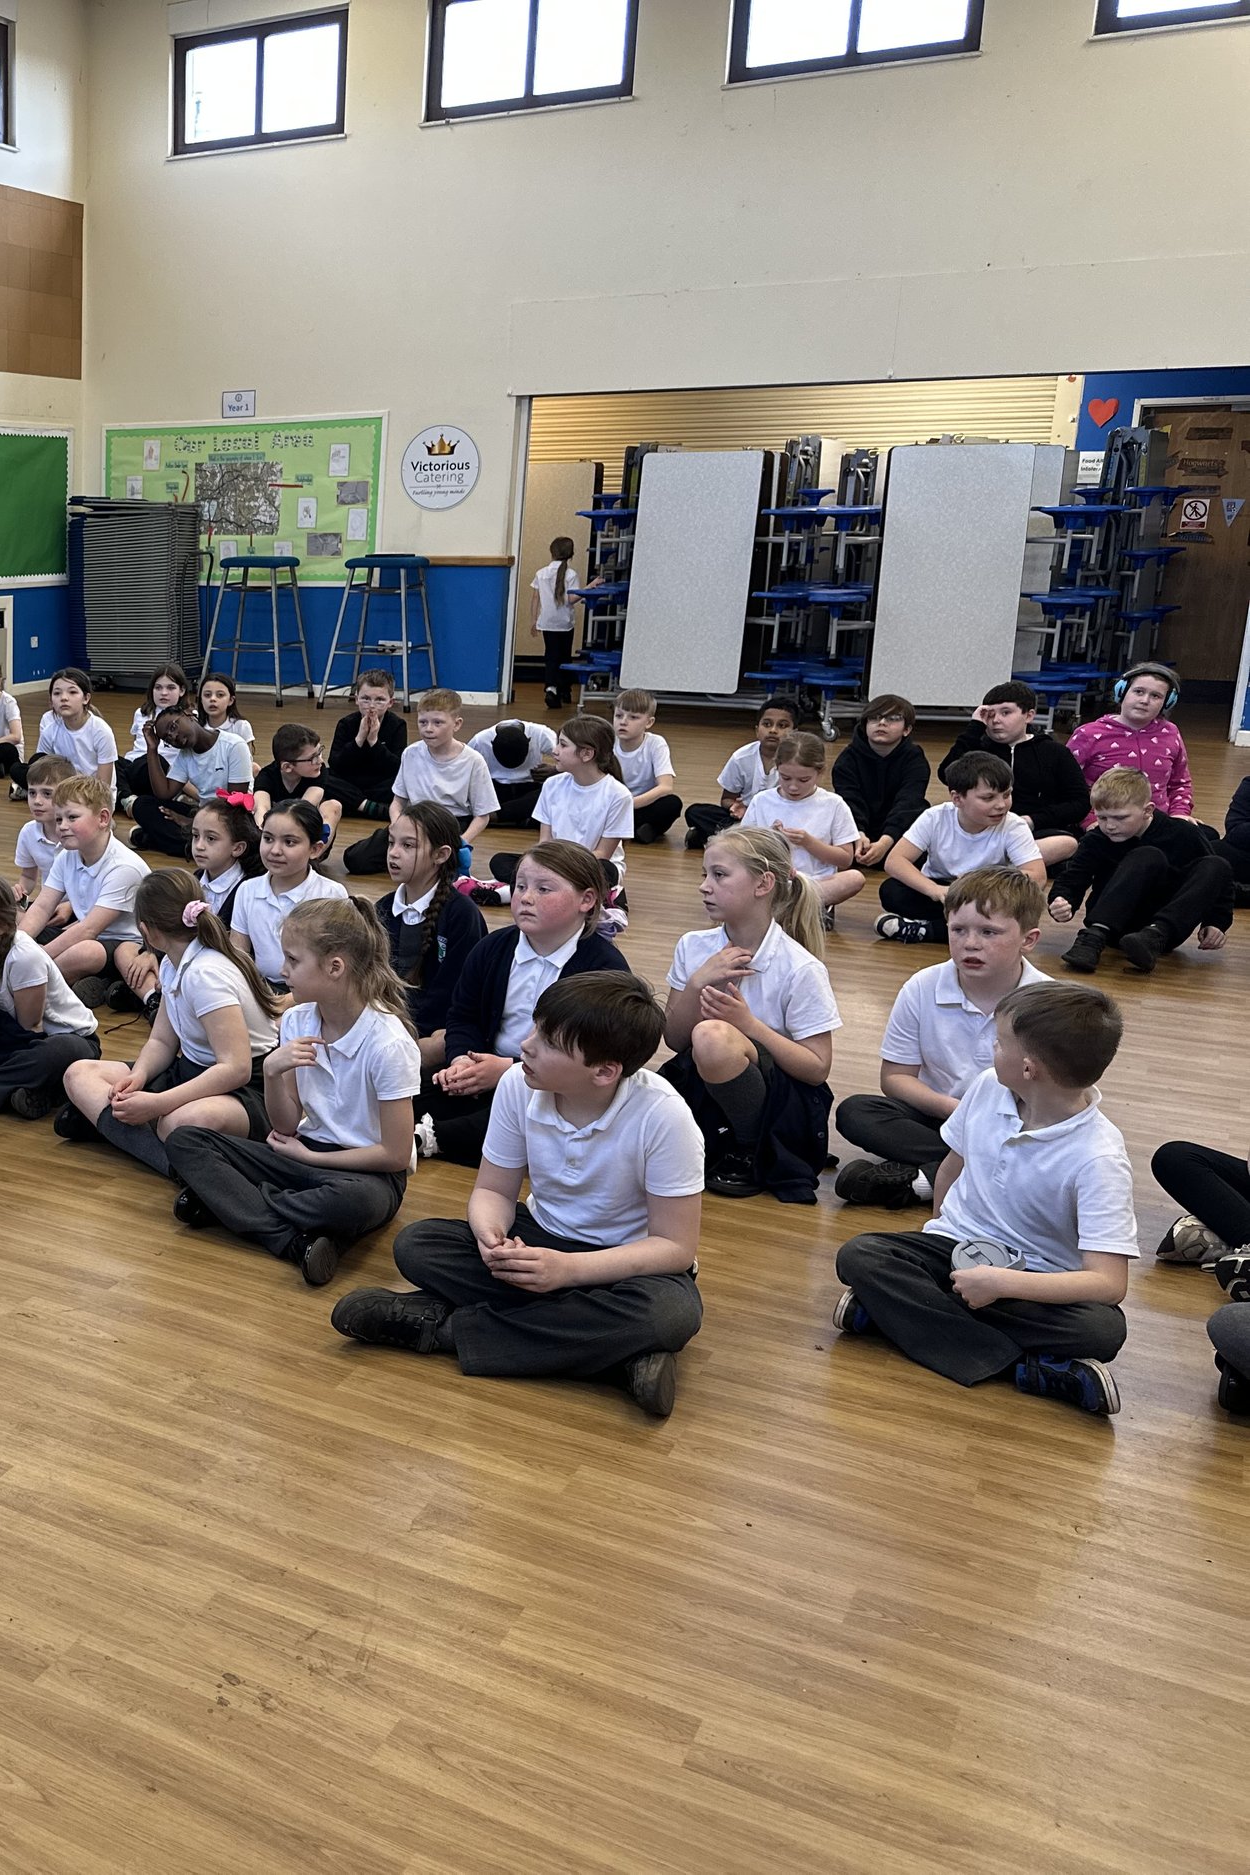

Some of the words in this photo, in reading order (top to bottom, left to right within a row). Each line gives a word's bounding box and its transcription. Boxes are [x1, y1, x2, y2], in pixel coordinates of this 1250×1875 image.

[227, 403, 244, 412] Year
[245, 403, 249, 411] 1
[174, 435, 206, 453] Our
[213, 432, 260, 452] Local
[271, 431, 314, 449] Area
[410, 460, 470, 472] Victorious
[414, 472, 464, 485] Catering
